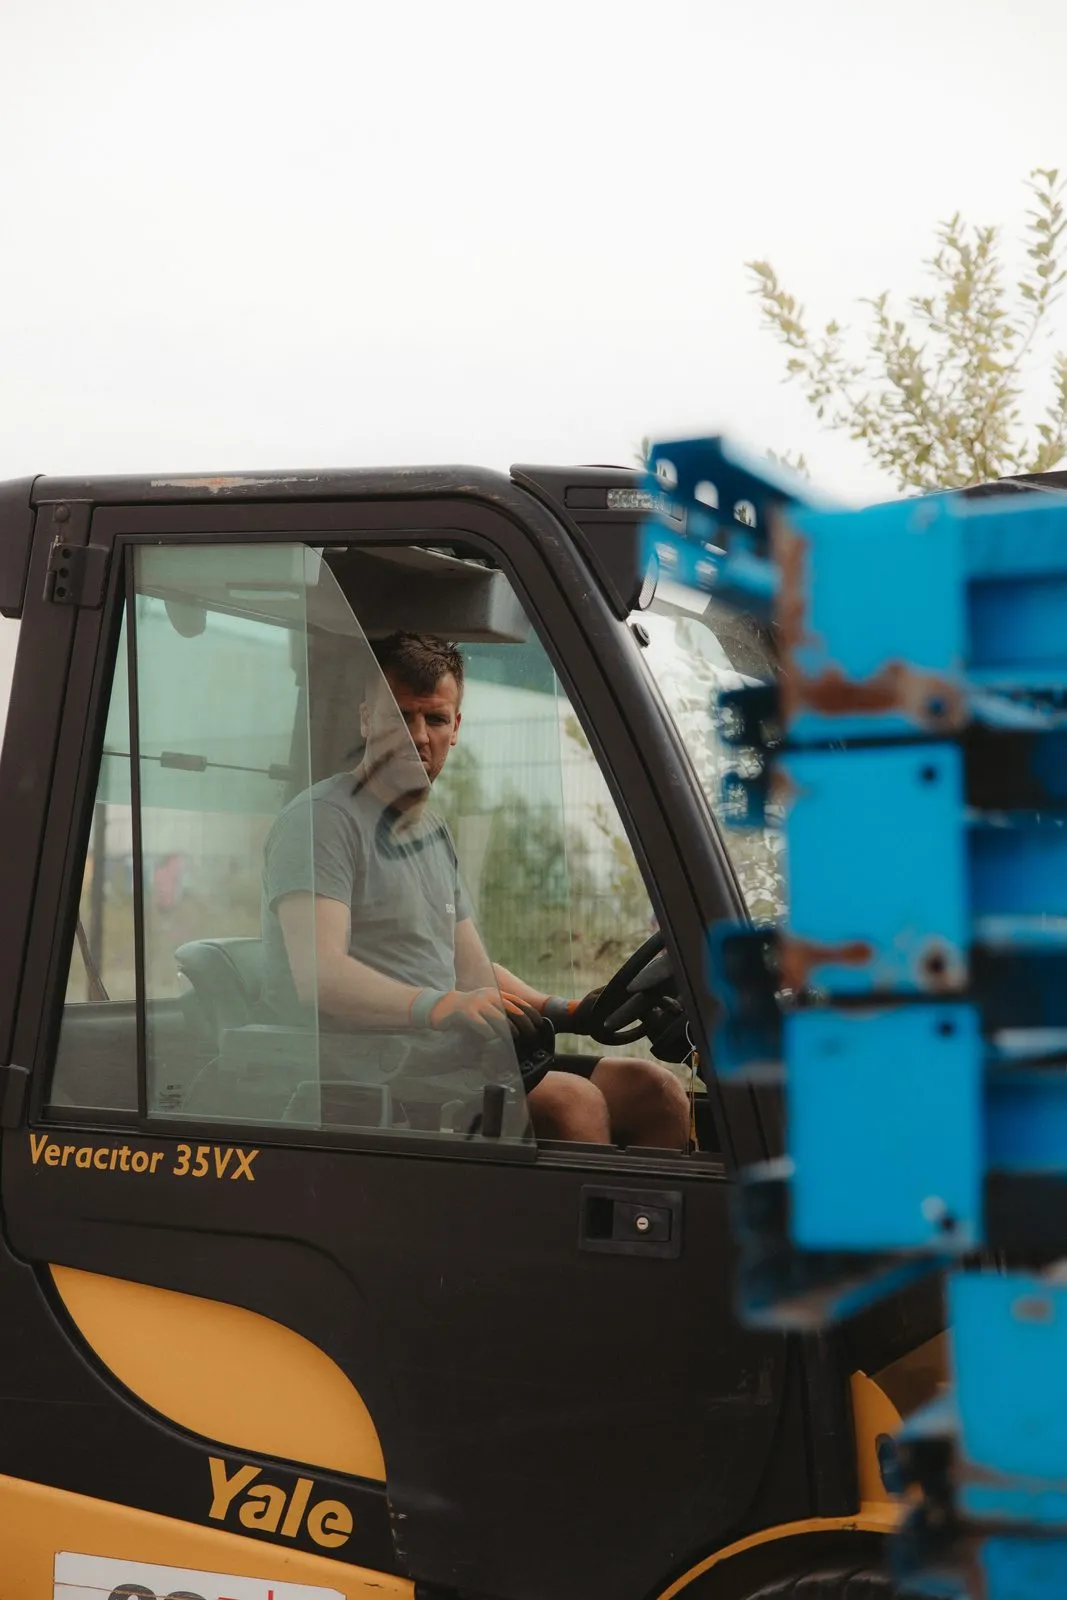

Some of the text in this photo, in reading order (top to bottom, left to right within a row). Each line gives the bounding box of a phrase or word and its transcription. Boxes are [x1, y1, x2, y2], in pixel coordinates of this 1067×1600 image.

[29, 1133, 260, 1181] Veracitor 35VX
[208, 1456, 354, 1548] Yale
